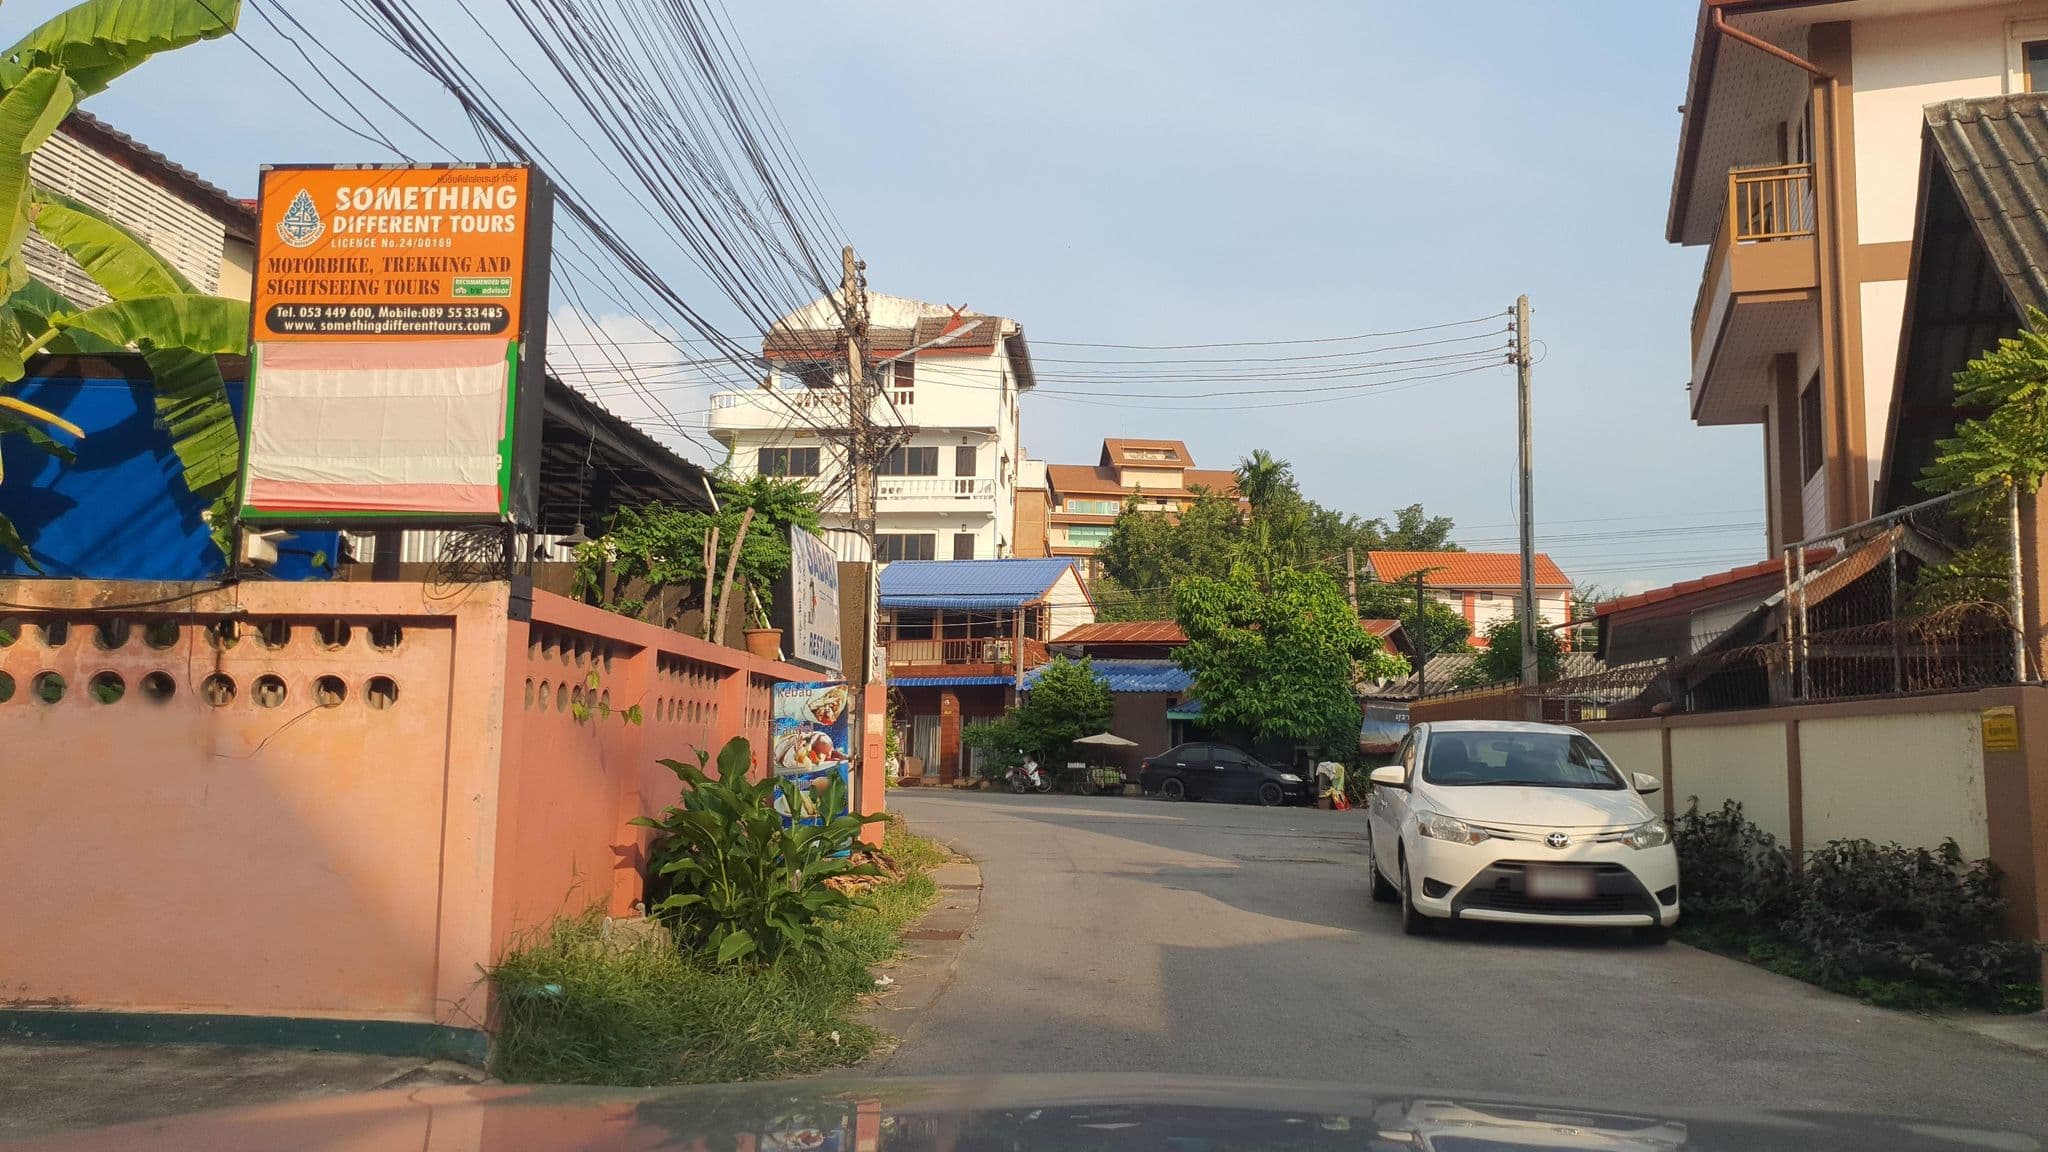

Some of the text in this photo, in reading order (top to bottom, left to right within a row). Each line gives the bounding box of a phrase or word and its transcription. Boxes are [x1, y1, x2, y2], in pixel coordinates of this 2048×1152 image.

[335, 185, 518, 211] SOMETHING
[332, 214, 516, 234] DIFFERENT TOURS
[331, 238, 377, 249] LICENCE
[266, 256, 511, 275] MOTORBIKE, TREKKING AND
[265, 278, 441, 296] SIGHTSEEING TOURS
[276, 306, 296, 318] Tel.
[299, 306, 322, 318] 053
[325, 306, 347, 318] 449
[350, 306, 375, 319] 600,
[808, 631, 840, 665] RESTAURANT
[777, 687, 812, 699] Kebab
